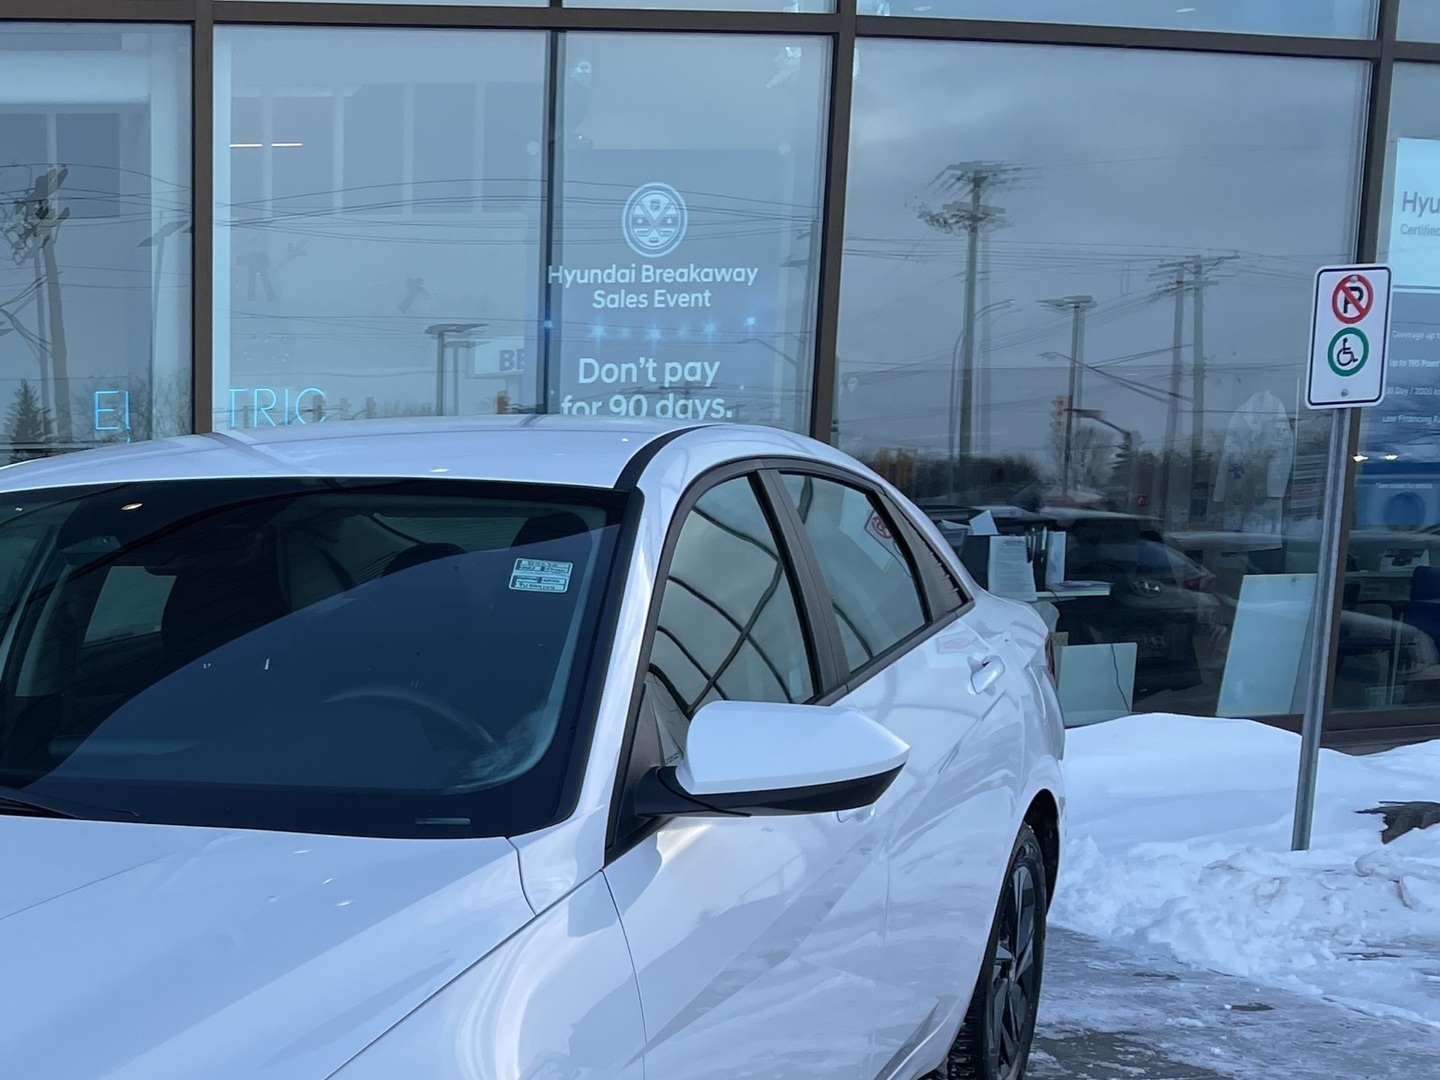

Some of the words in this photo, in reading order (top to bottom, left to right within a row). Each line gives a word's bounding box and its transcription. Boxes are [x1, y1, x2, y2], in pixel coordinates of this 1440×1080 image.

[548, 263, 636, 288] Hyundai
[641, 263, 759, 286] Breakaway
[592, 289, 648, 308] Sales
[654, 289, 712, 308] Event
[664, 360, 721, 388] pay
[1395, 387, 1409, 396] Day
[561, 395, 603, 415] for
[609, 394, 648, 418] 90
[656, 393, 733, 421] days.
